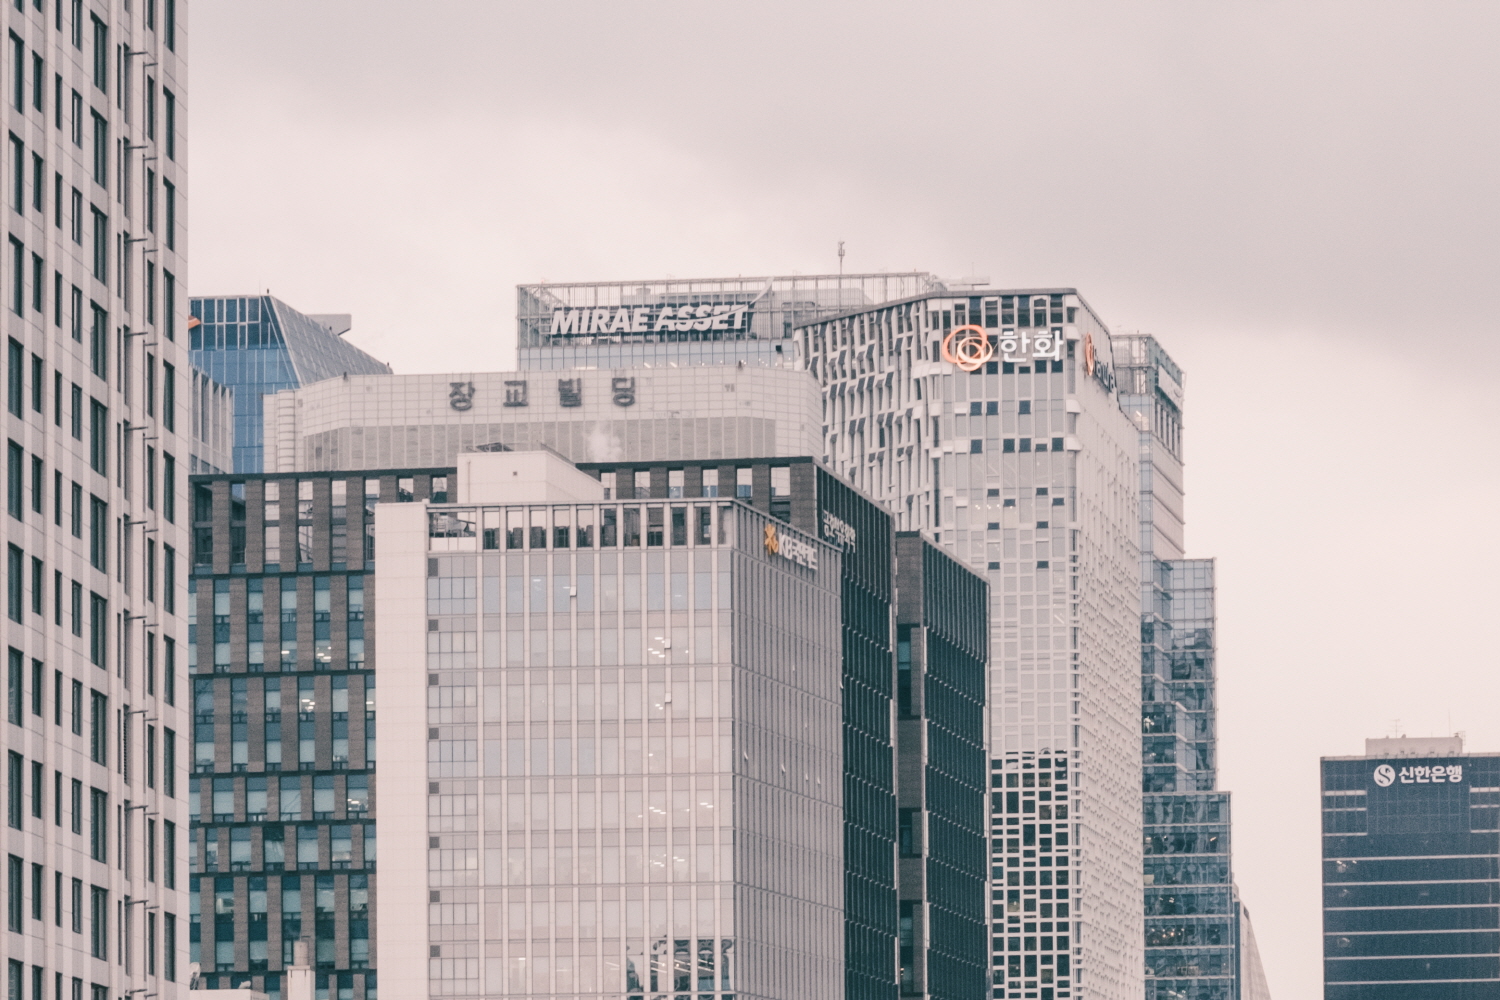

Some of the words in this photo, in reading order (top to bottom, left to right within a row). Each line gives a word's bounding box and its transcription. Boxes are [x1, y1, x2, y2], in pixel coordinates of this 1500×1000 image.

[550, 308, 650, 335] MIRAE
[653, 304, 749, 332] ASSET
[999, 330, 1064, 363] 한화
[448, 376, 636, 412] 장교빌딩
[1399, 765, 1462, 783] 신한은행
